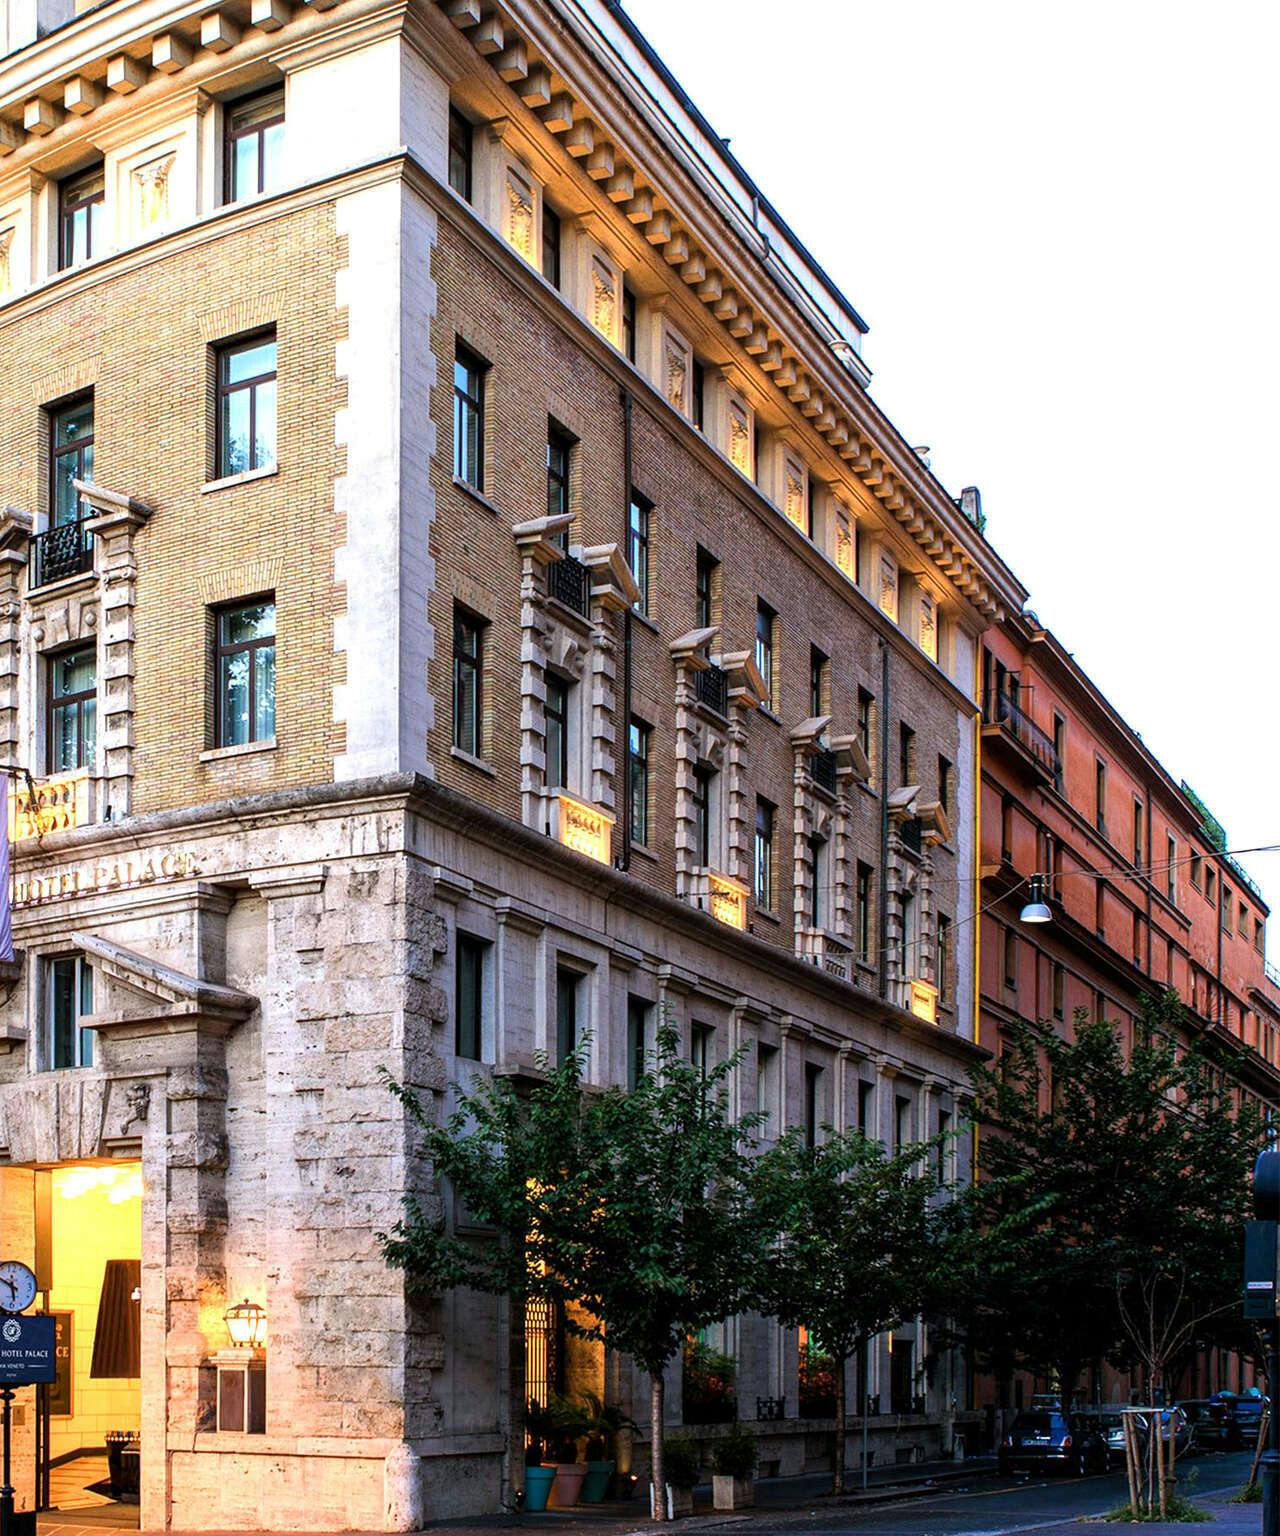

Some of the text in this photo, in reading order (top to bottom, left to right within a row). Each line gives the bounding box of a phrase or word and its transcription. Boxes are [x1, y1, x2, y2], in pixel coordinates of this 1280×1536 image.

[94, 851, 202, 891] PALACE
[1, 1350, 23, 1358] HOTEL
[25, 1350, 48, 1358] PALACE
